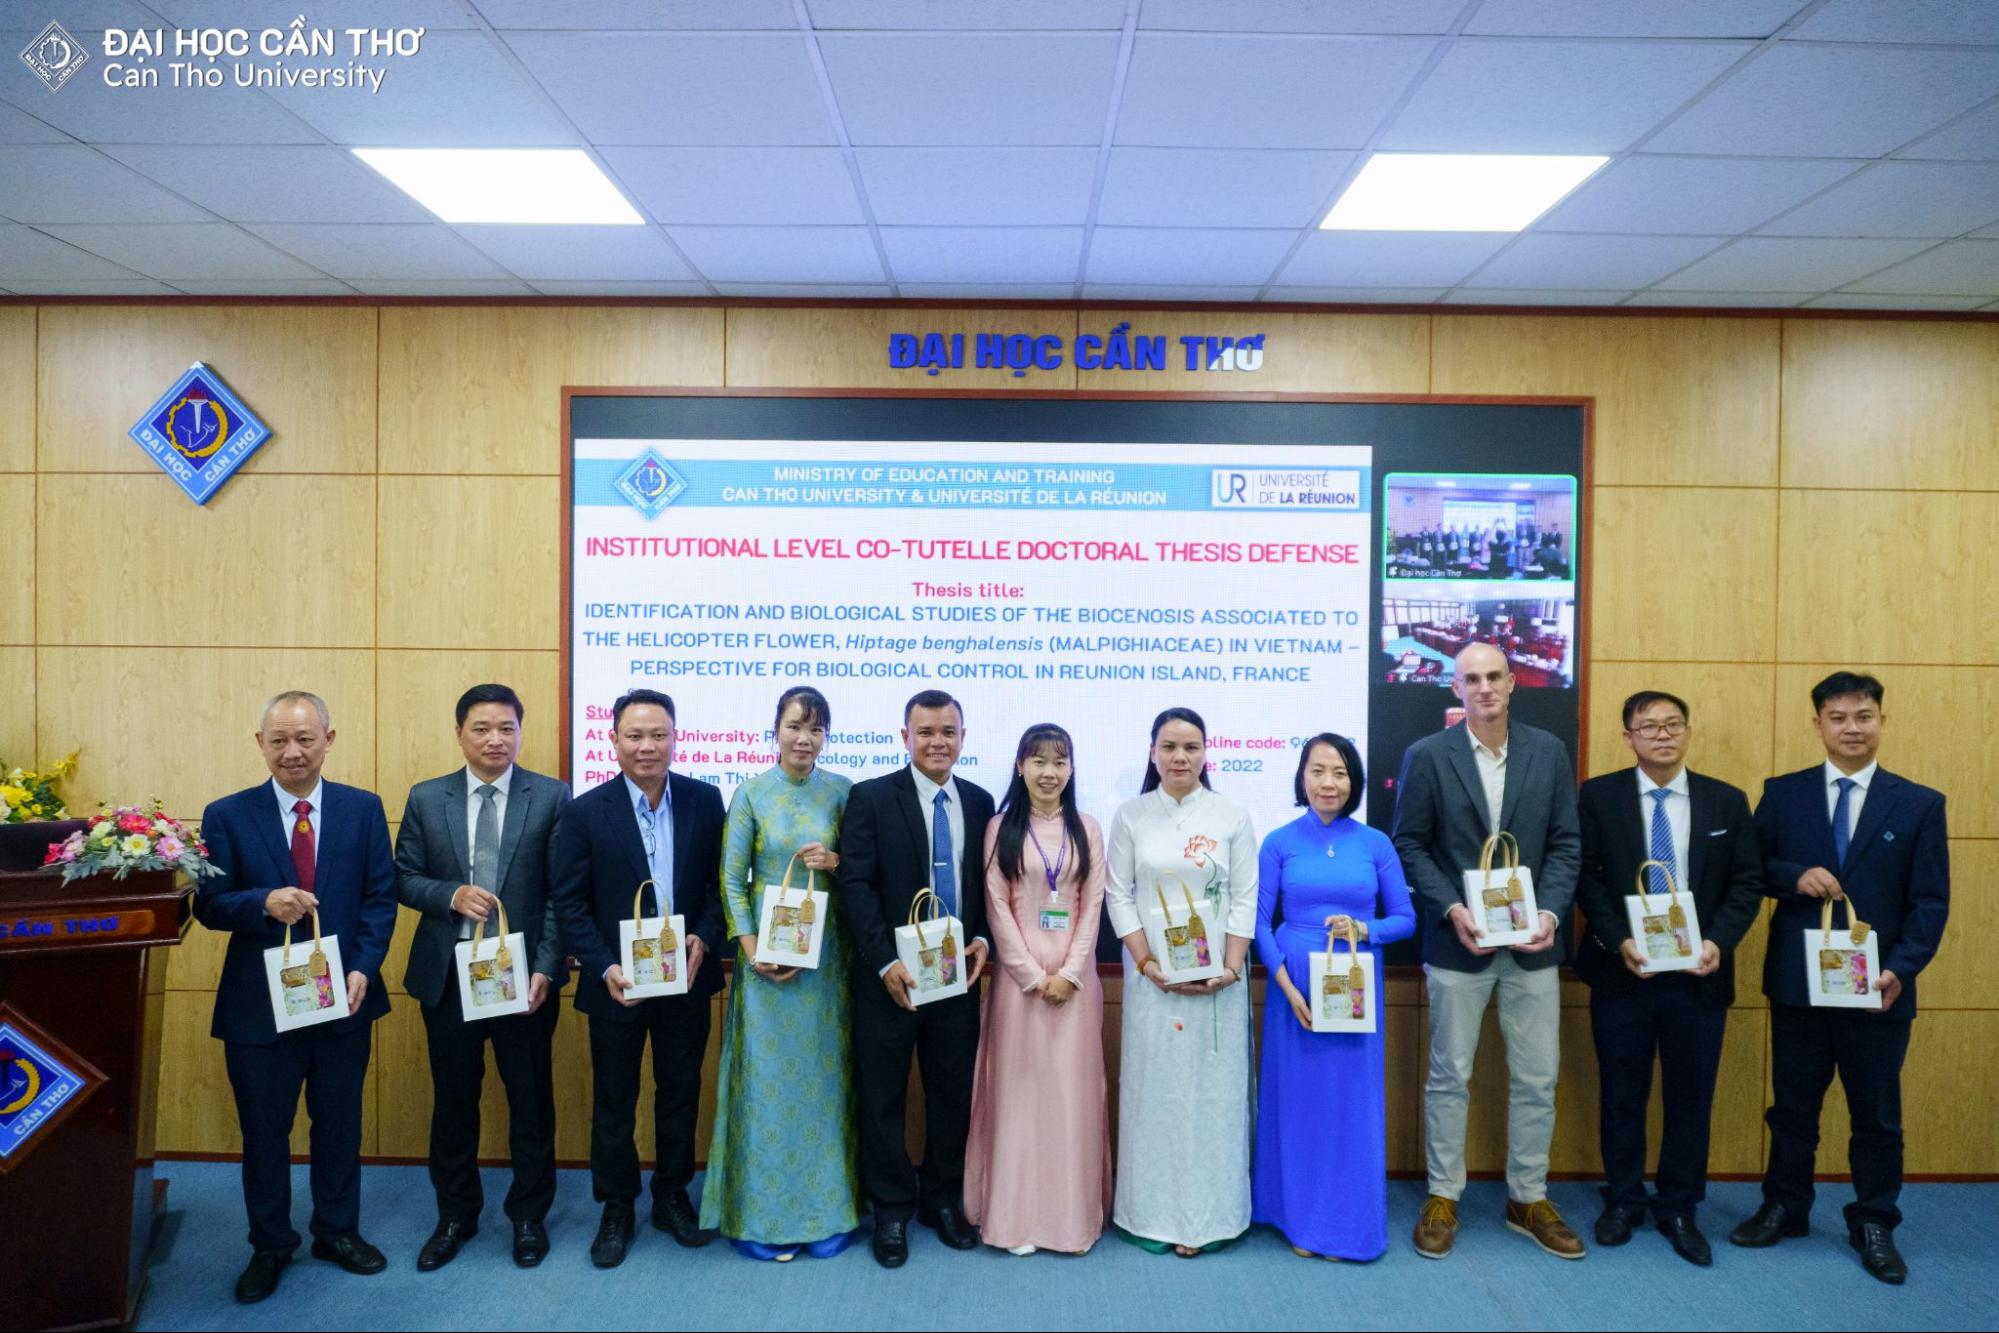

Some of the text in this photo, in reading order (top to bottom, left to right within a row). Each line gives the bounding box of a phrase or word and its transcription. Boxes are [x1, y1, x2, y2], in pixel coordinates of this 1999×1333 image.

[888, 333, 963, 375] ĐẠI
[976, 333, 1063, 377] HỌC
[1180, 333, 1265, 371] THƠ
[774, 467, 1115, 484] MINISTRY OF EDUCATION AND TRAINING
[1259, 472, 1328, 488] UNIVERSITÉ
[722, 486, 1167, 505] CAN THO UNIVERSITY & UNIVERSITÉ DE LA RÉUNION
[1259, 488, 1355, 504] DE LA RÉUNION
[586, 537, 1359, 564] INSTITUTIONAL LEVEL CO-TUTELLE DOCTORAL THESIS DEFENSE
[912, 582, 1024, 598] Thesis title:
[585, 603, 1359, 626] IDENTIFICATION AND BIOLOGICAL STUDIES OF THE BIOCENOSIS ASSOCIATED TO
[583, 632, 620, 646] THE
[627, 632, 749, 648] HELICOPTER
[754, 633, 840, 651] FLOWER,
[845, 635, 917, 653] Hiptage
[923, 635, 1043, 653] benghalensis
[1049, 636, 1223, 654] (MALPIGHIACEAE)
[1230, 638, 1247, 653] IN
[1254, 638, 1342, 653] VIETNAM
[631, 660, 1311, 683] PERSPECTIVE FOR BIOLOGICAL CONTROL IN REUNION ISLAND, FRANCE
[586, 729, 604, 740] At
[675, 729, 760, 745] University:
[1246, 736, 1286, 749] code:
[586, 750, 604, 761] At
[692, 751, 710, 762] de
[714, 751, 732, 763] La
[817, 753, 867, 767] cology
[872, 753, 900, 765] and
[1221, 760, 1263, 772] 2022
